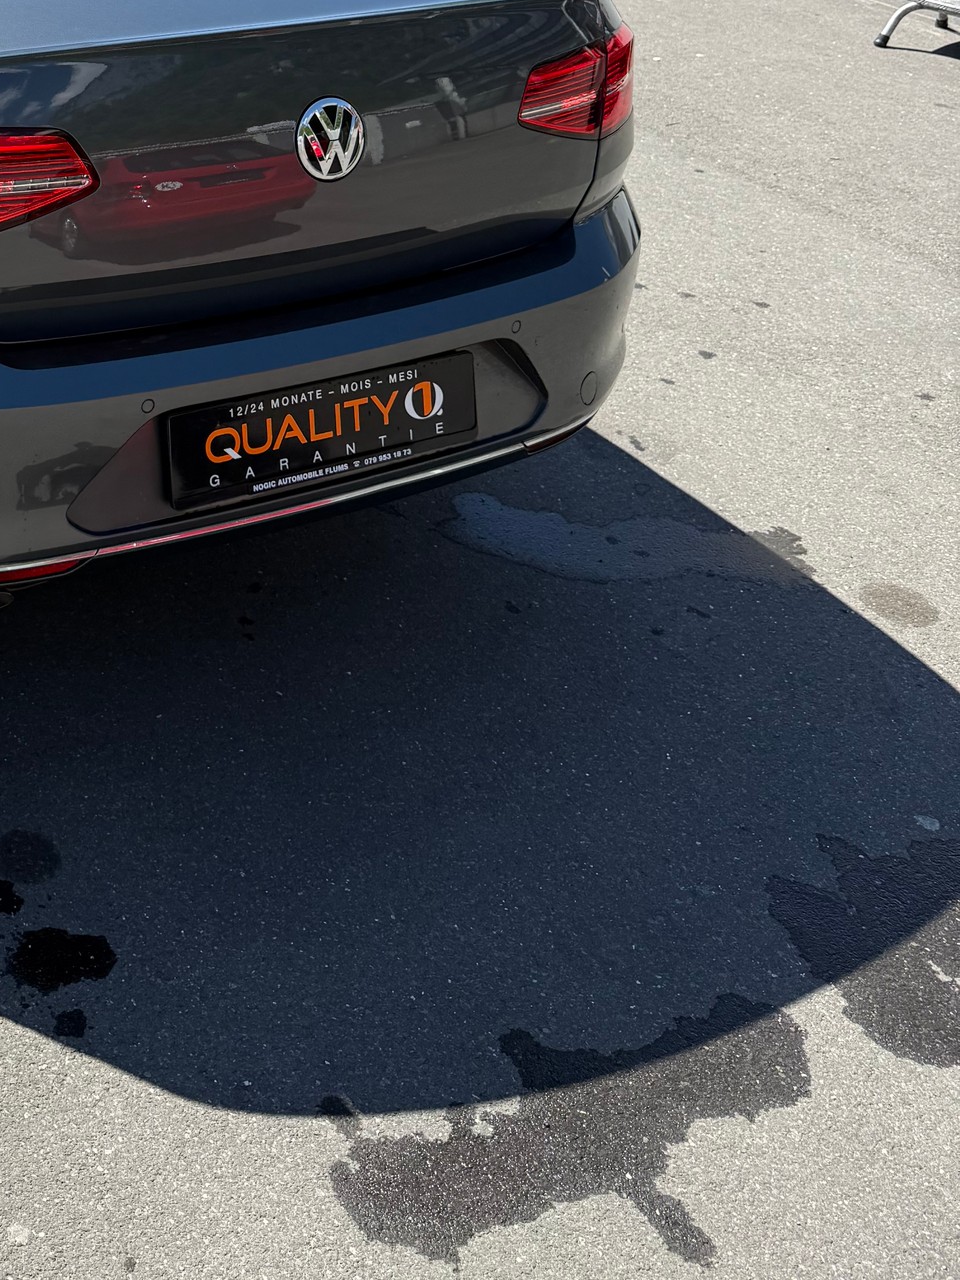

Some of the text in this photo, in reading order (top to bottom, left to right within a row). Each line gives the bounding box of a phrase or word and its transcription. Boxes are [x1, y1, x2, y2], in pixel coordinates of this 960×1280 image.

[229, 402, 264, 418] 12/24
[271, 389, 323, 409] MONATE
[340, 379, 371, 394] MOIS
[388, 369, 418, 384] MESI
[205, 390, 399, 464] QUALITY
[209, 422, 444, 488] GARANTIE
[253, 480, 277, 492] NOGIC
[278, 468, 324, 486] AUTOMOBILE
[325, 463, 349, 476] FLUMS
[364, 456, 378, 465] 079
